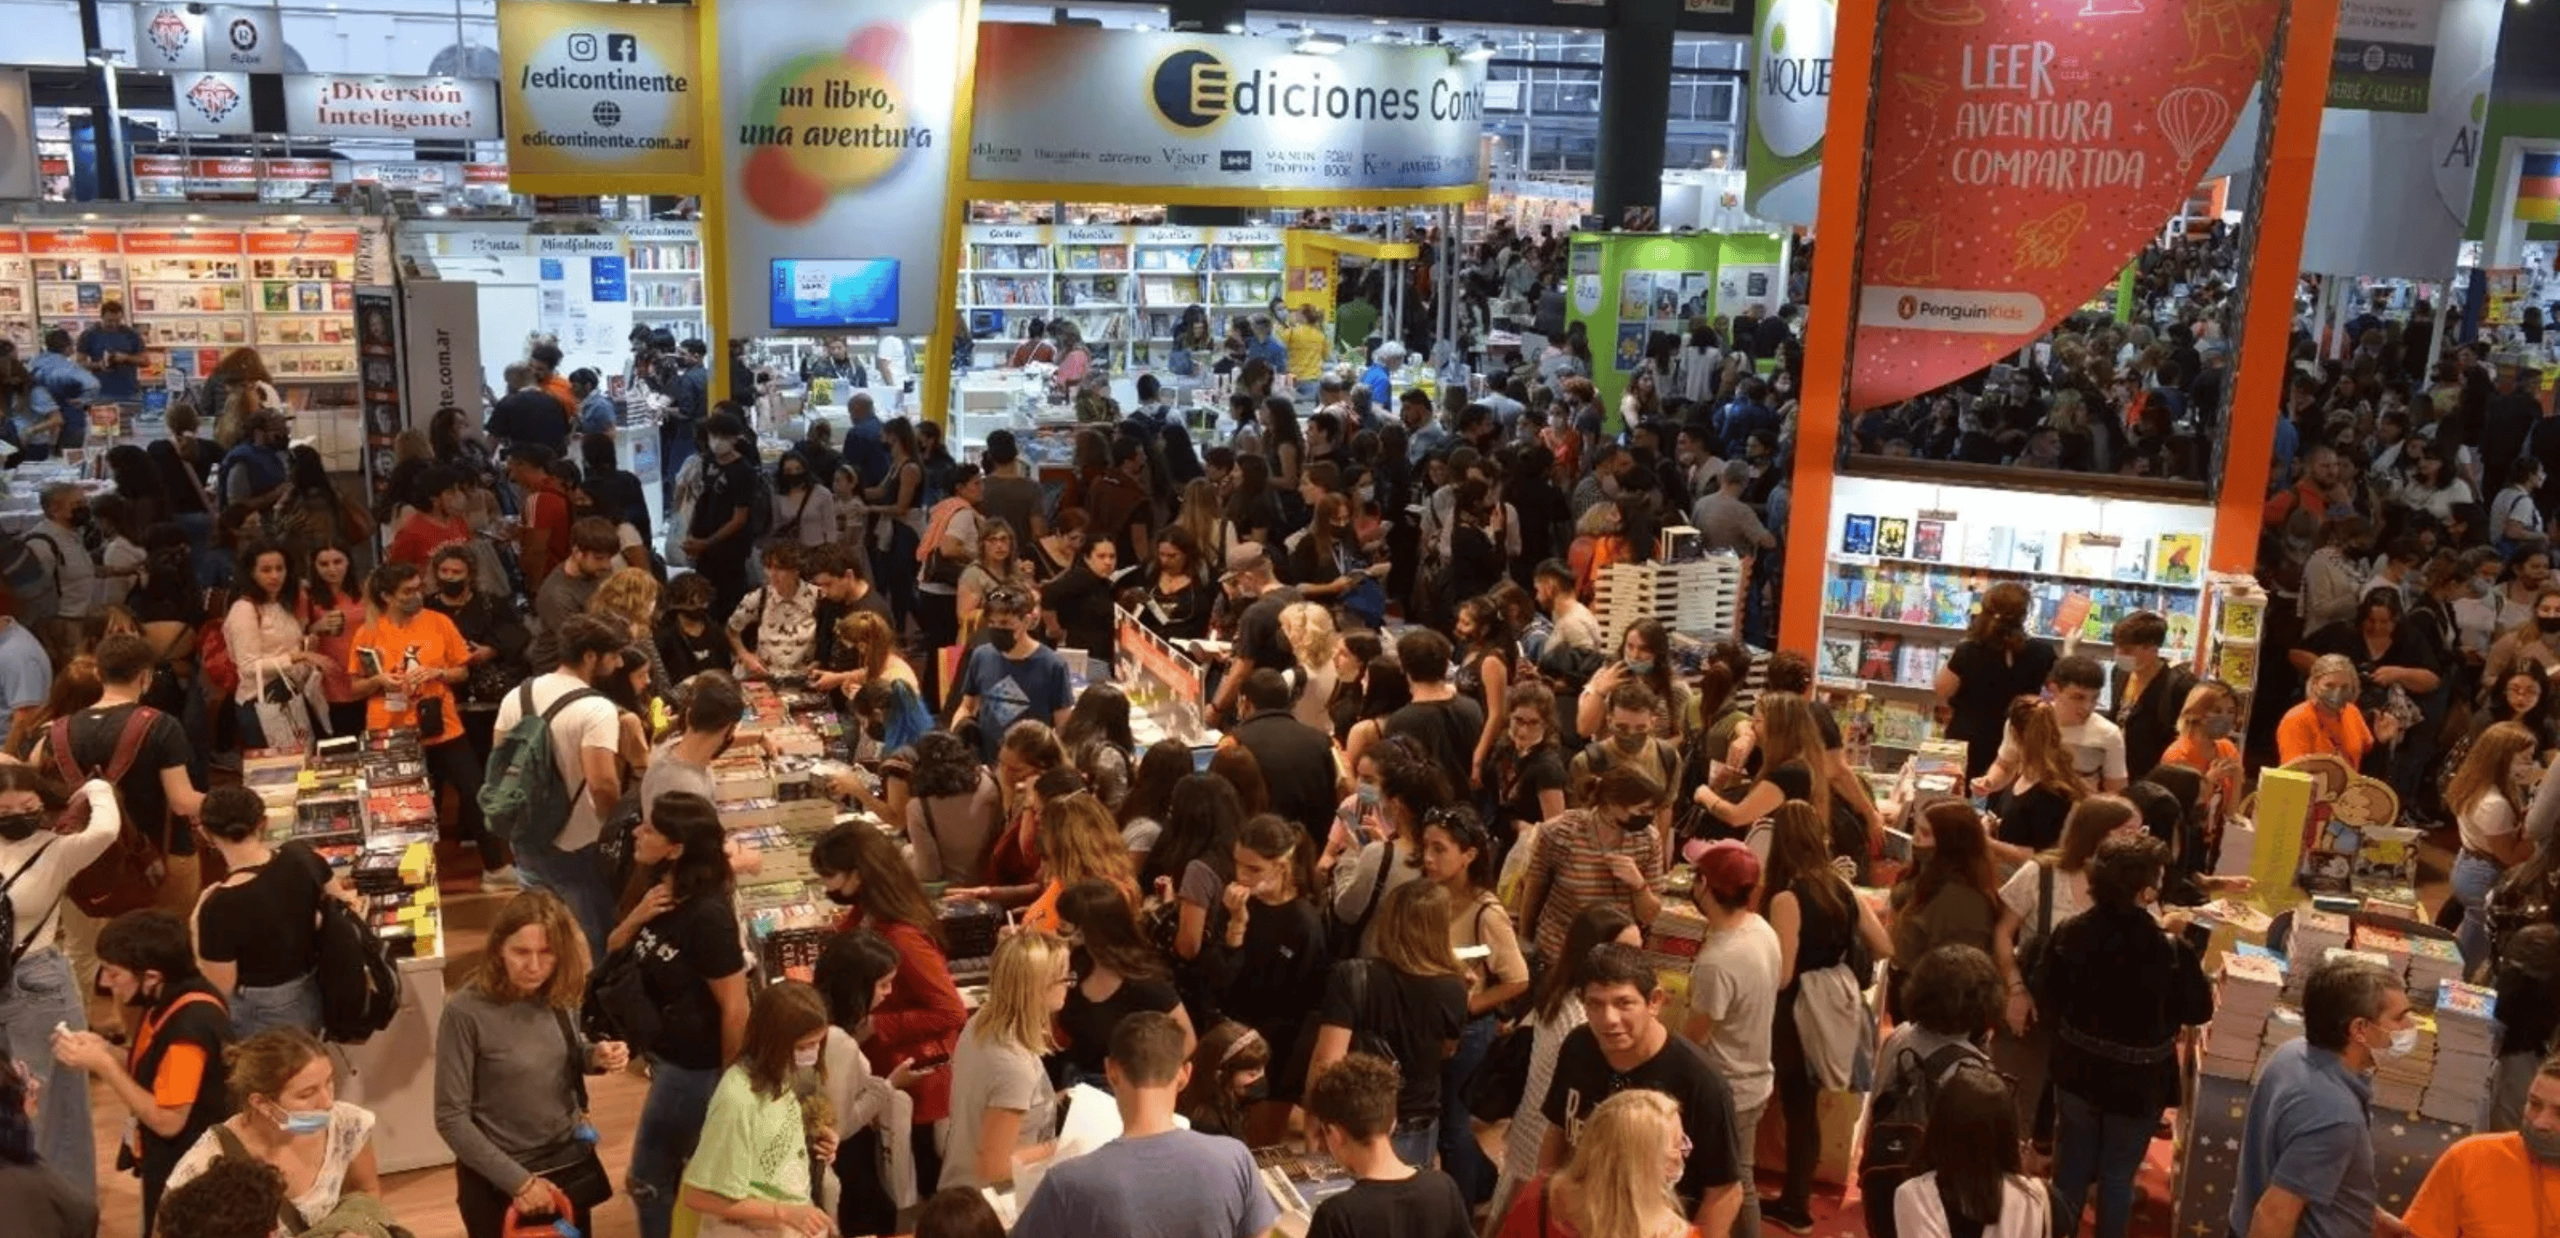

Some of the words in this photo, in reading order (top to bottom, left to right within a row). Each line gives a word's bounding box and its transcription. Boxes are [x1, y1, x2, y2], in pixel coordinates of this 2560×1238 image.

[521, 65, 688, 92] /edicontinente
[1961, 40, 2055, 100] LEER
[321, 81, 462, 105] ¡Diversión
[780, 86, 814, 107] un
[824, 79, 895, 114] libro,
[318, 106, 472, 131] Inteligente!
[1956, 99, 2113, 144] AVENTURA
[522, 130, 691, 150] edicontinente.com.ar
[739, 124, 793, 147] una
[803, 124, 932, 149] aventura
[1952, 148, 2146, 193] COMPARTIDA
[540, 238, 614, 254] Mindfulness
